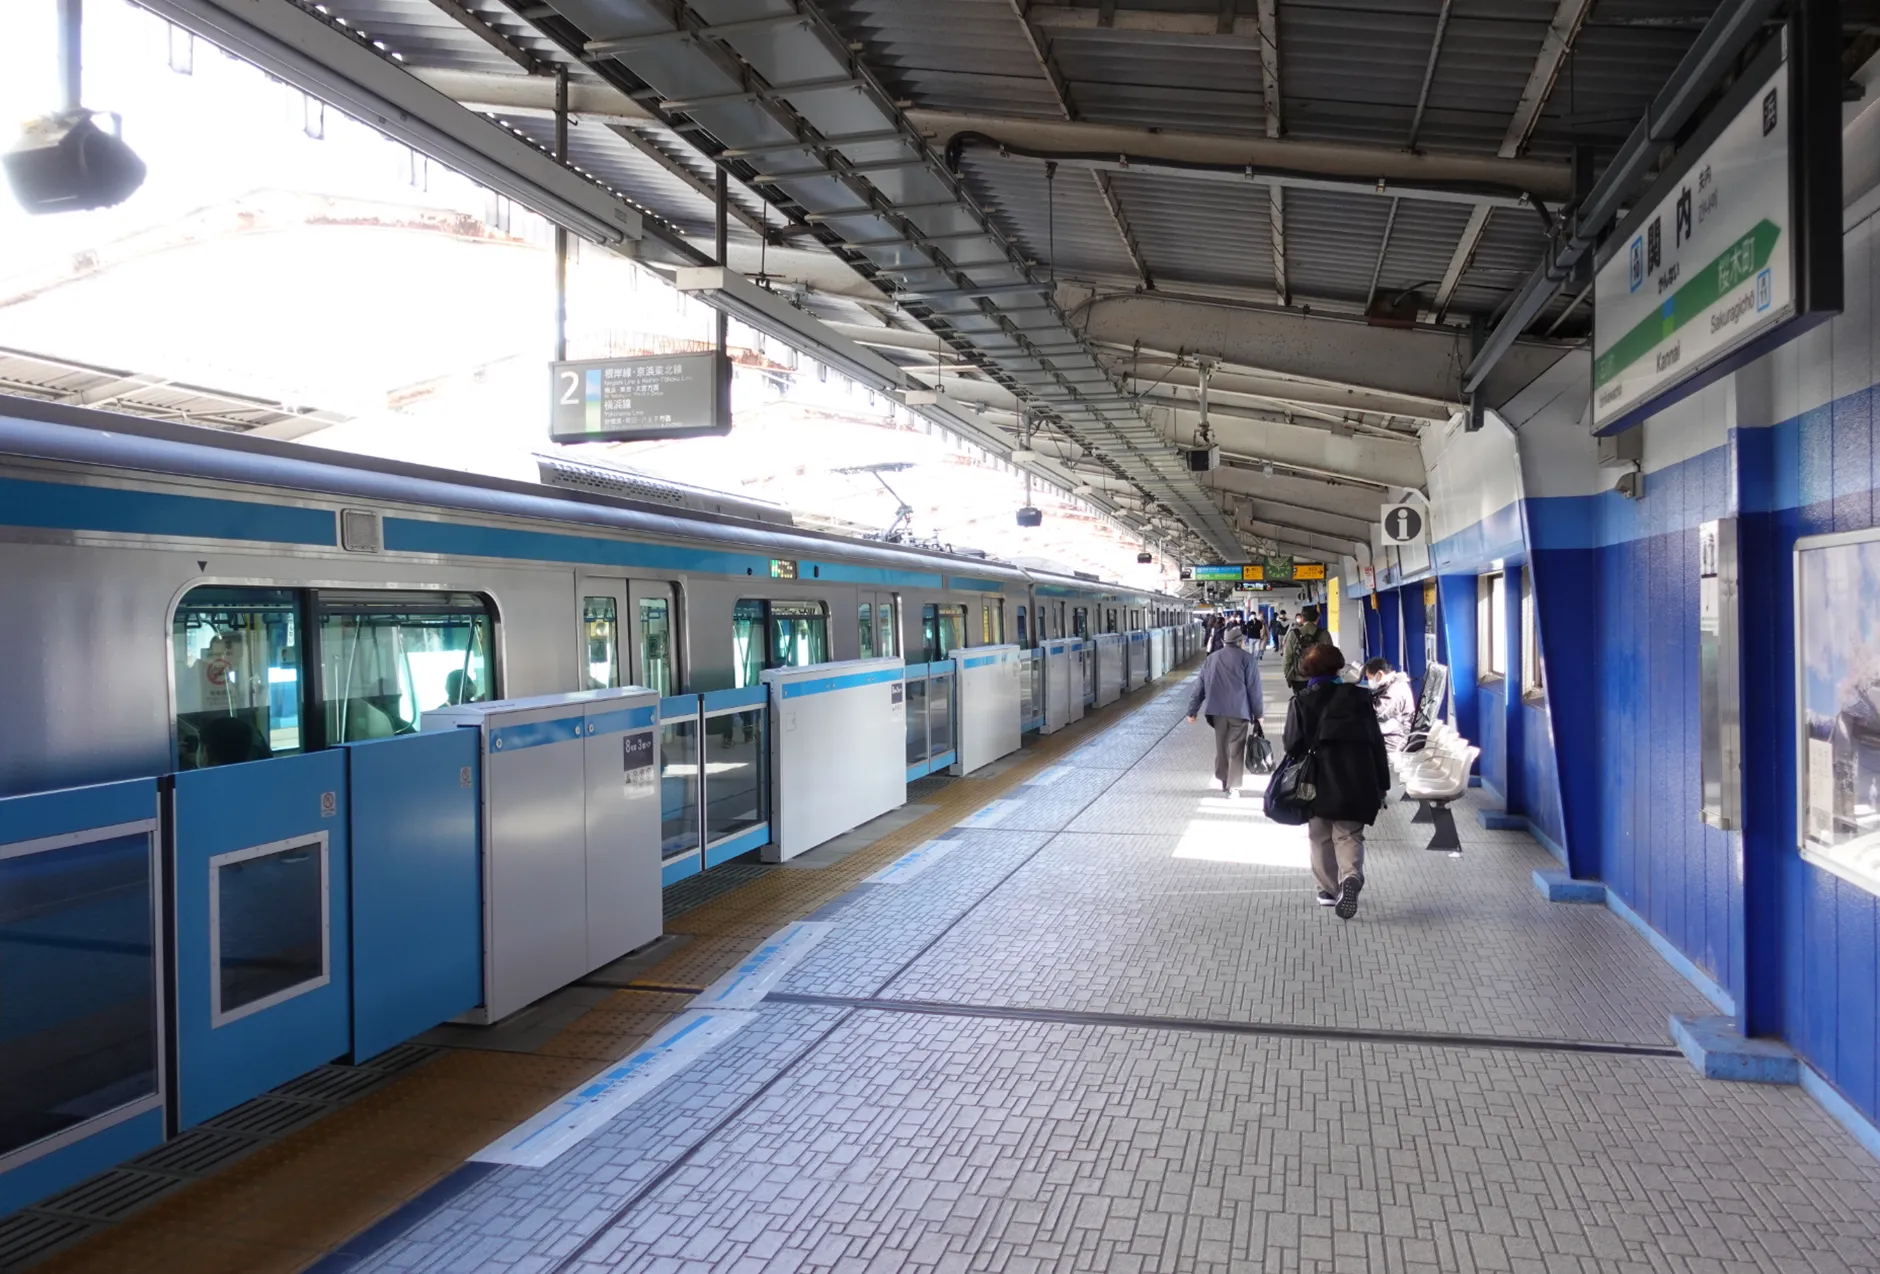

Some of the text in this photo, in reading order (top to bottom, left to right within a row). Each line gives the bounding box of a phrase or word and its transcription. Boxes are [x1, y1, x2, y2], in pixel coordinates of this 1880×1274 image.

[1647, 186, 1692, 277] 関内
[1719, 237, 1756, 294] 桜木町
[1656, 344, 1681, 374] Kannai
[560, 371, 580, 405] 2
